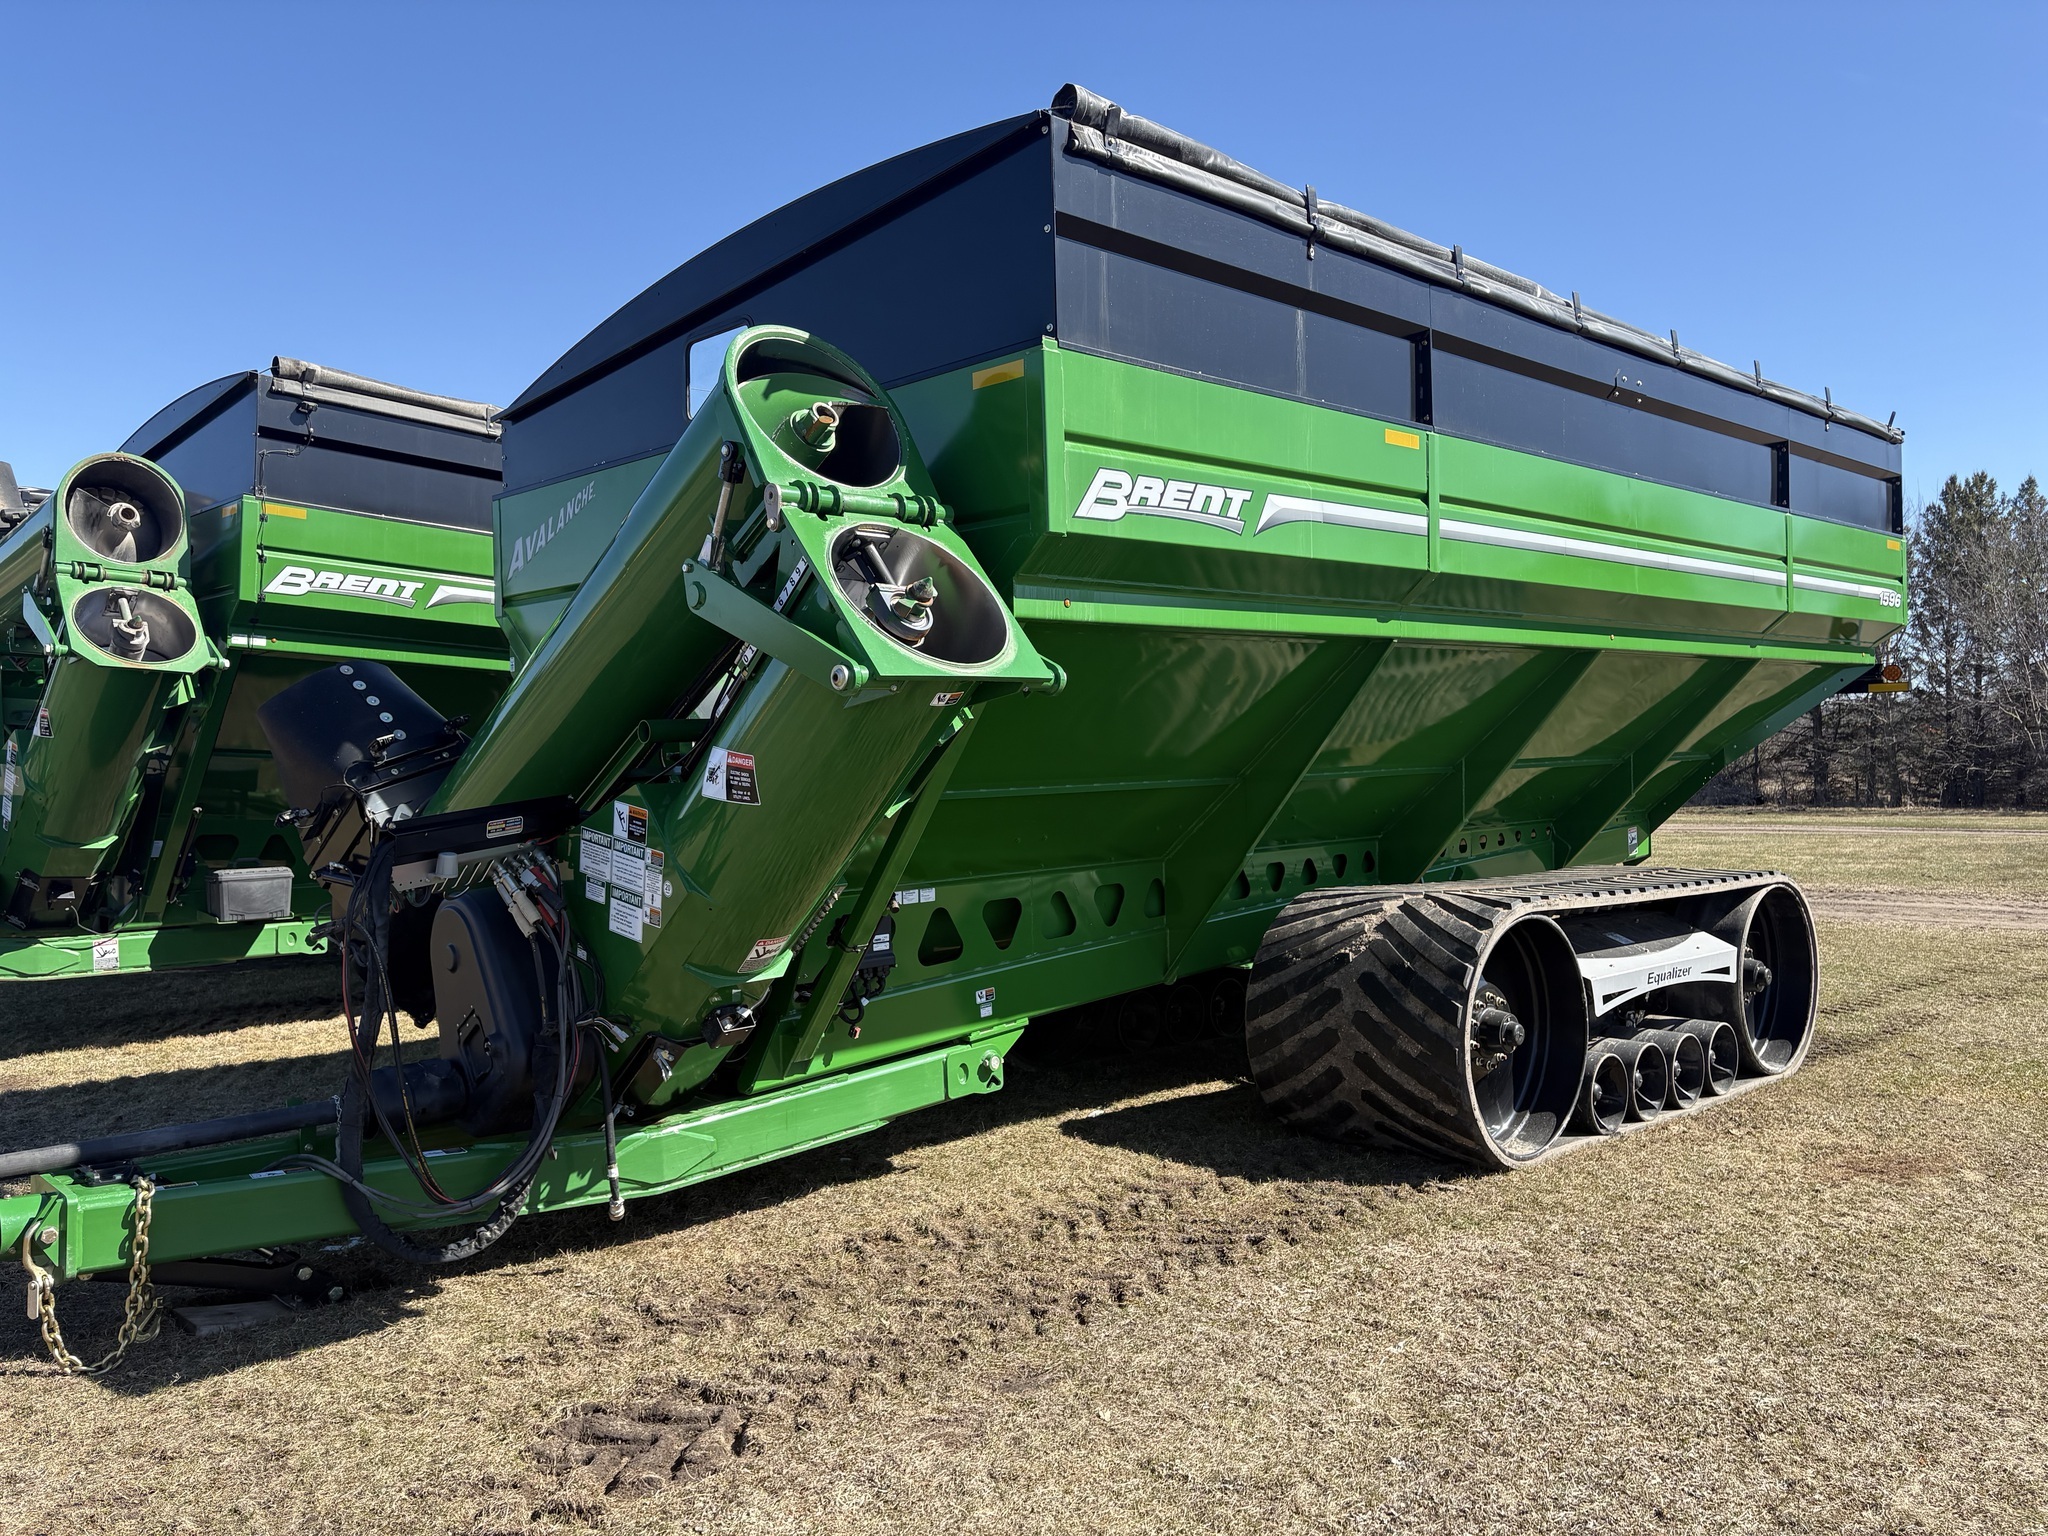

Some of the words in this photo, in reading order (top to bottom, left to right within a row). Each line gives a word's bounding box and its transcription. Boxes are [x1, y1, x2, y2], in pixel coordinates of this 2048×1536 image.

[1072, 466, 1254, 522] BRENT
[506, 480, 595, 582] AVALANCHE
[262, 565, 426, 601] BRENT
[778, 597, 784, 606] 6
[784, 587, 790, 597] 7
[790, 577, 796, 587] 8
[795, 567, 801, 577] 9
[1879, 591, 1902, 608] 1596
[732, 756, 753, 767] DANGER
[582, 829, 611, 848] IMPORTANT
[614, 839, 644, 859] IMPORTANT
[612, 887, 642, 907] IMPORTANT
[1647, 966, 1692, 986] Equalizer
